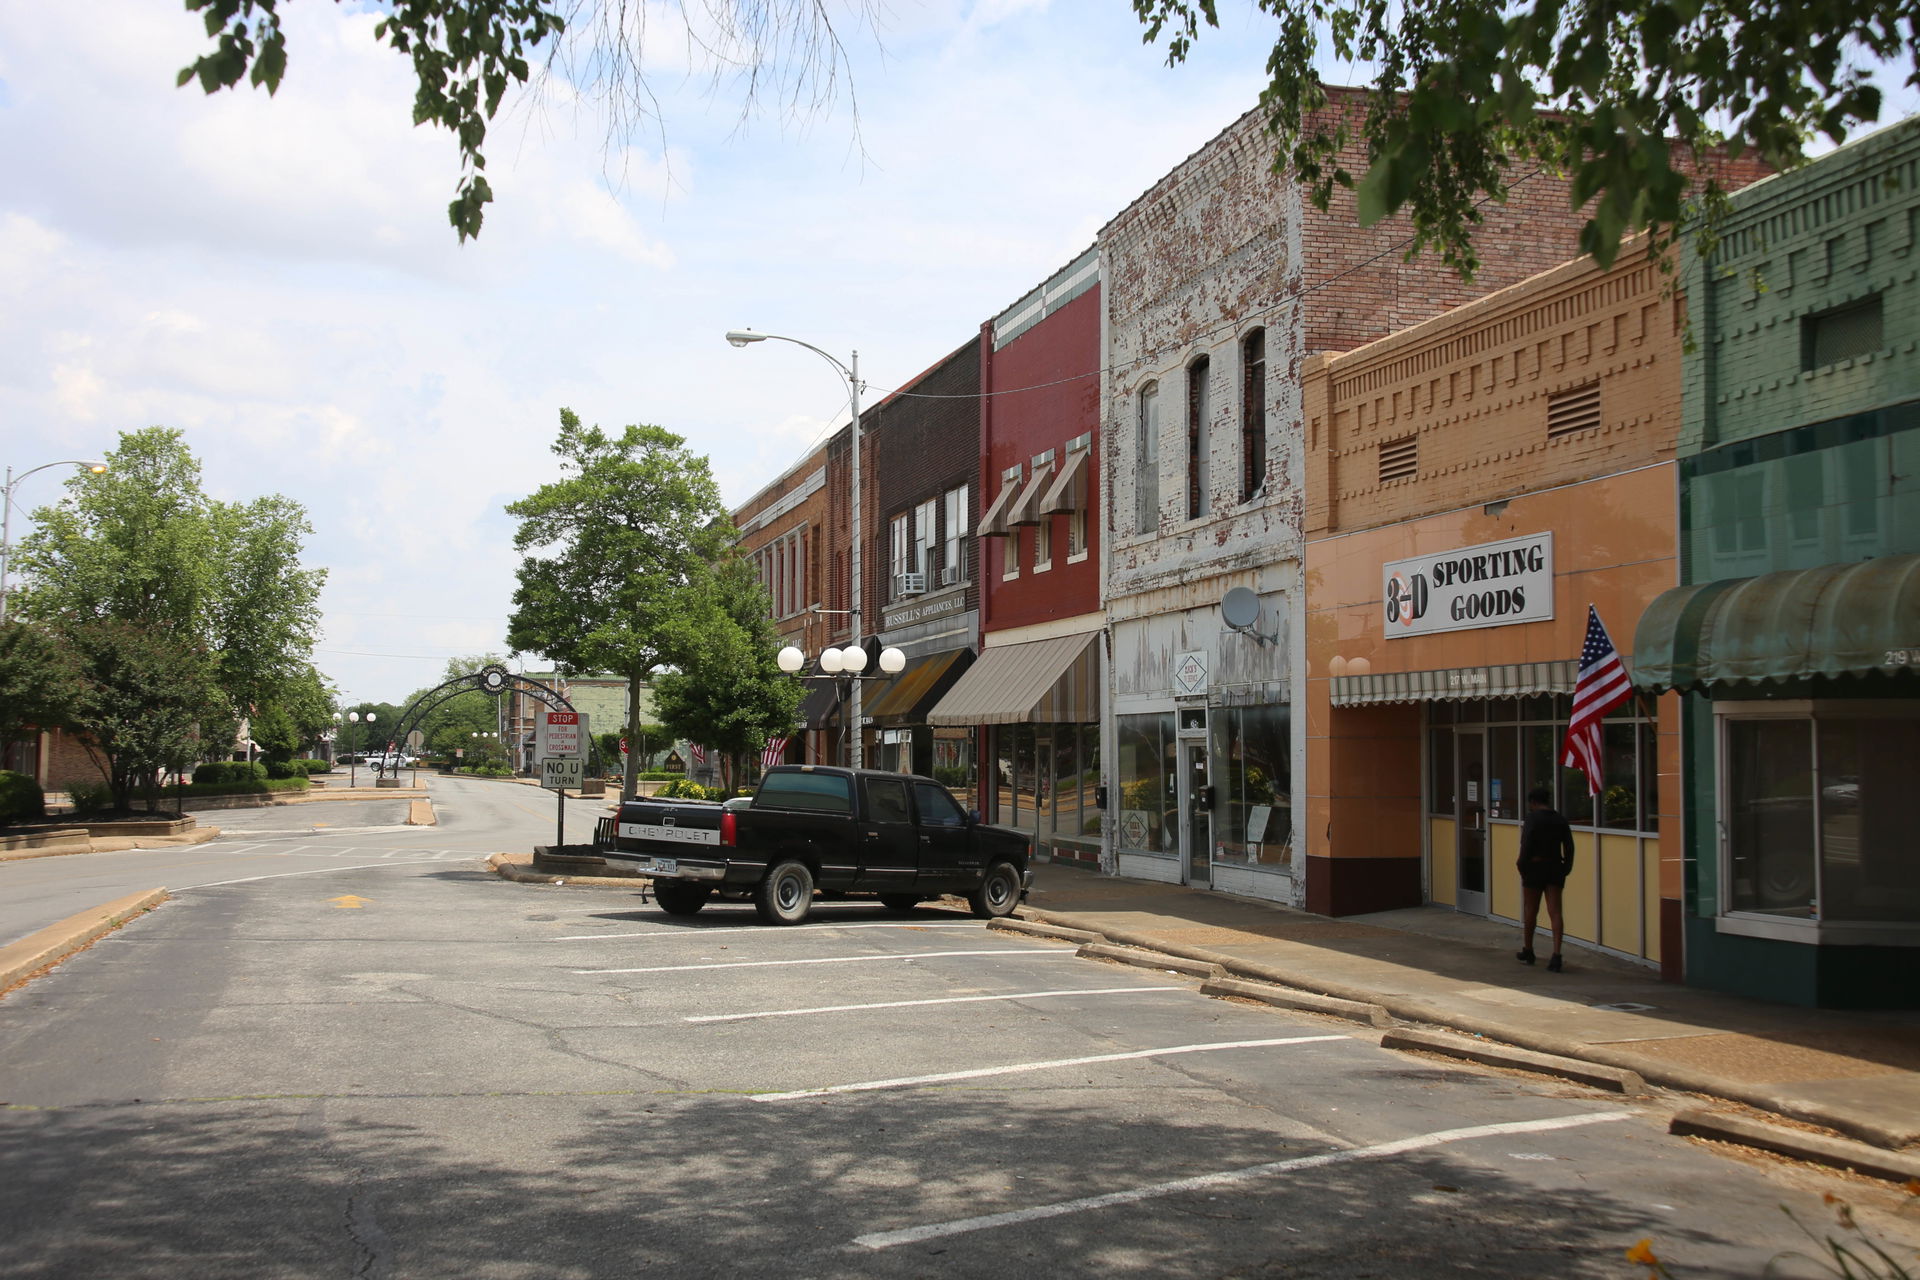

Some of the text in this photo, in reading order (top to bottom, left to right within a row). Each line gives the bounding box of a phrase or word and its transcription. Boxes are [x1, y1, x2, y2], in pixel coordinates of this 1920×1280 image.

[1387, 544, 1544, 623] 3-D SPORTING
[1451, 585, 1526, 622] GOODS
[885, 608, 921, 629] RUSSELL'S
[954, 596, 966, 609] LLC
[1884, 650, 1905, 665] 219
[1450, 675, 1460, 686] 217
[1471, 672, 1487, 684] MAIN
[552, 714, 574, 723] STOP
[546, 762, 579, 774] NO U
[549, 776, 575, 785] TURN
[628, 826, 710, 841] CHEVROLET
